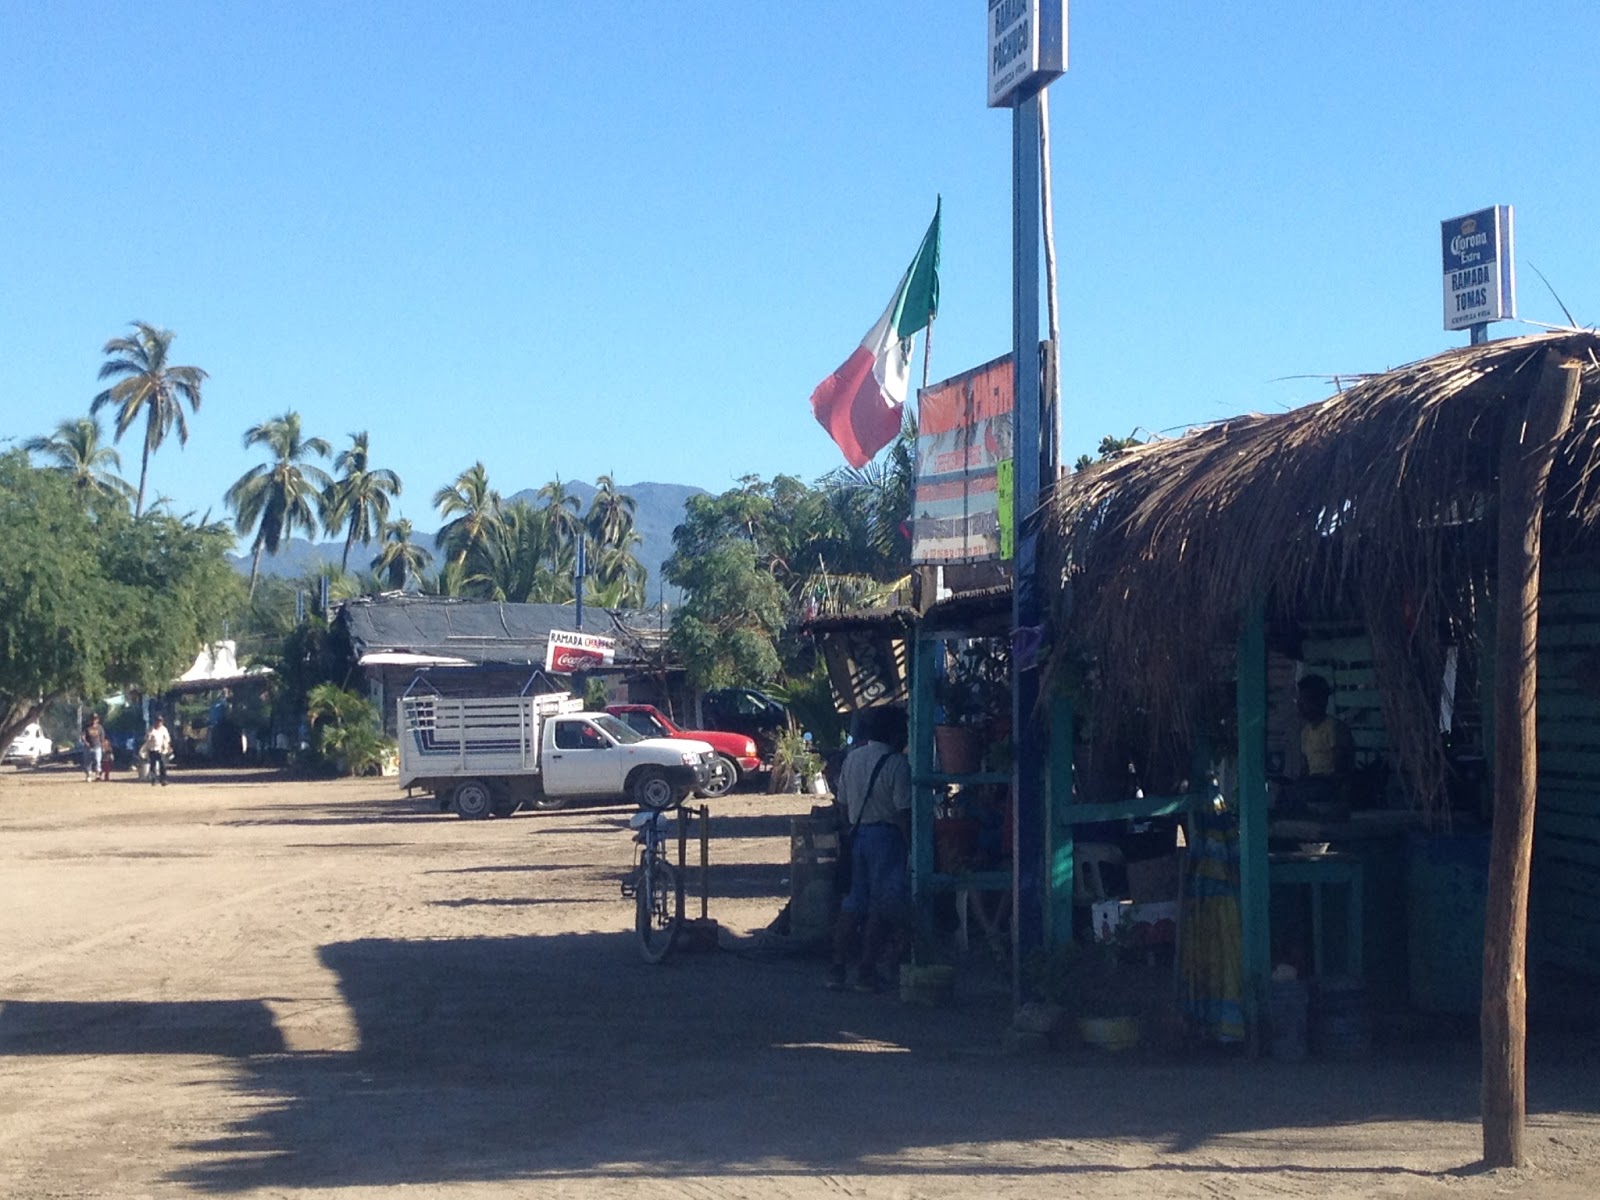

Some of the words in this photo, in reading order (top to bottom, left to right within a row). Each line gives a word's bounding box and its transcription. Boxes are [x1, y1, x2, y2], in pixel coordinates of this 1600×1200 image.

[1450, 232, 1487, 256] Corona
[1461, 251, 1481, 264] Extra
[1452, 265, 1490, 292] RAMADA
[1455, 287, 1487, 312] TOMAS
[551, 632, 583, 646] RAMADA
